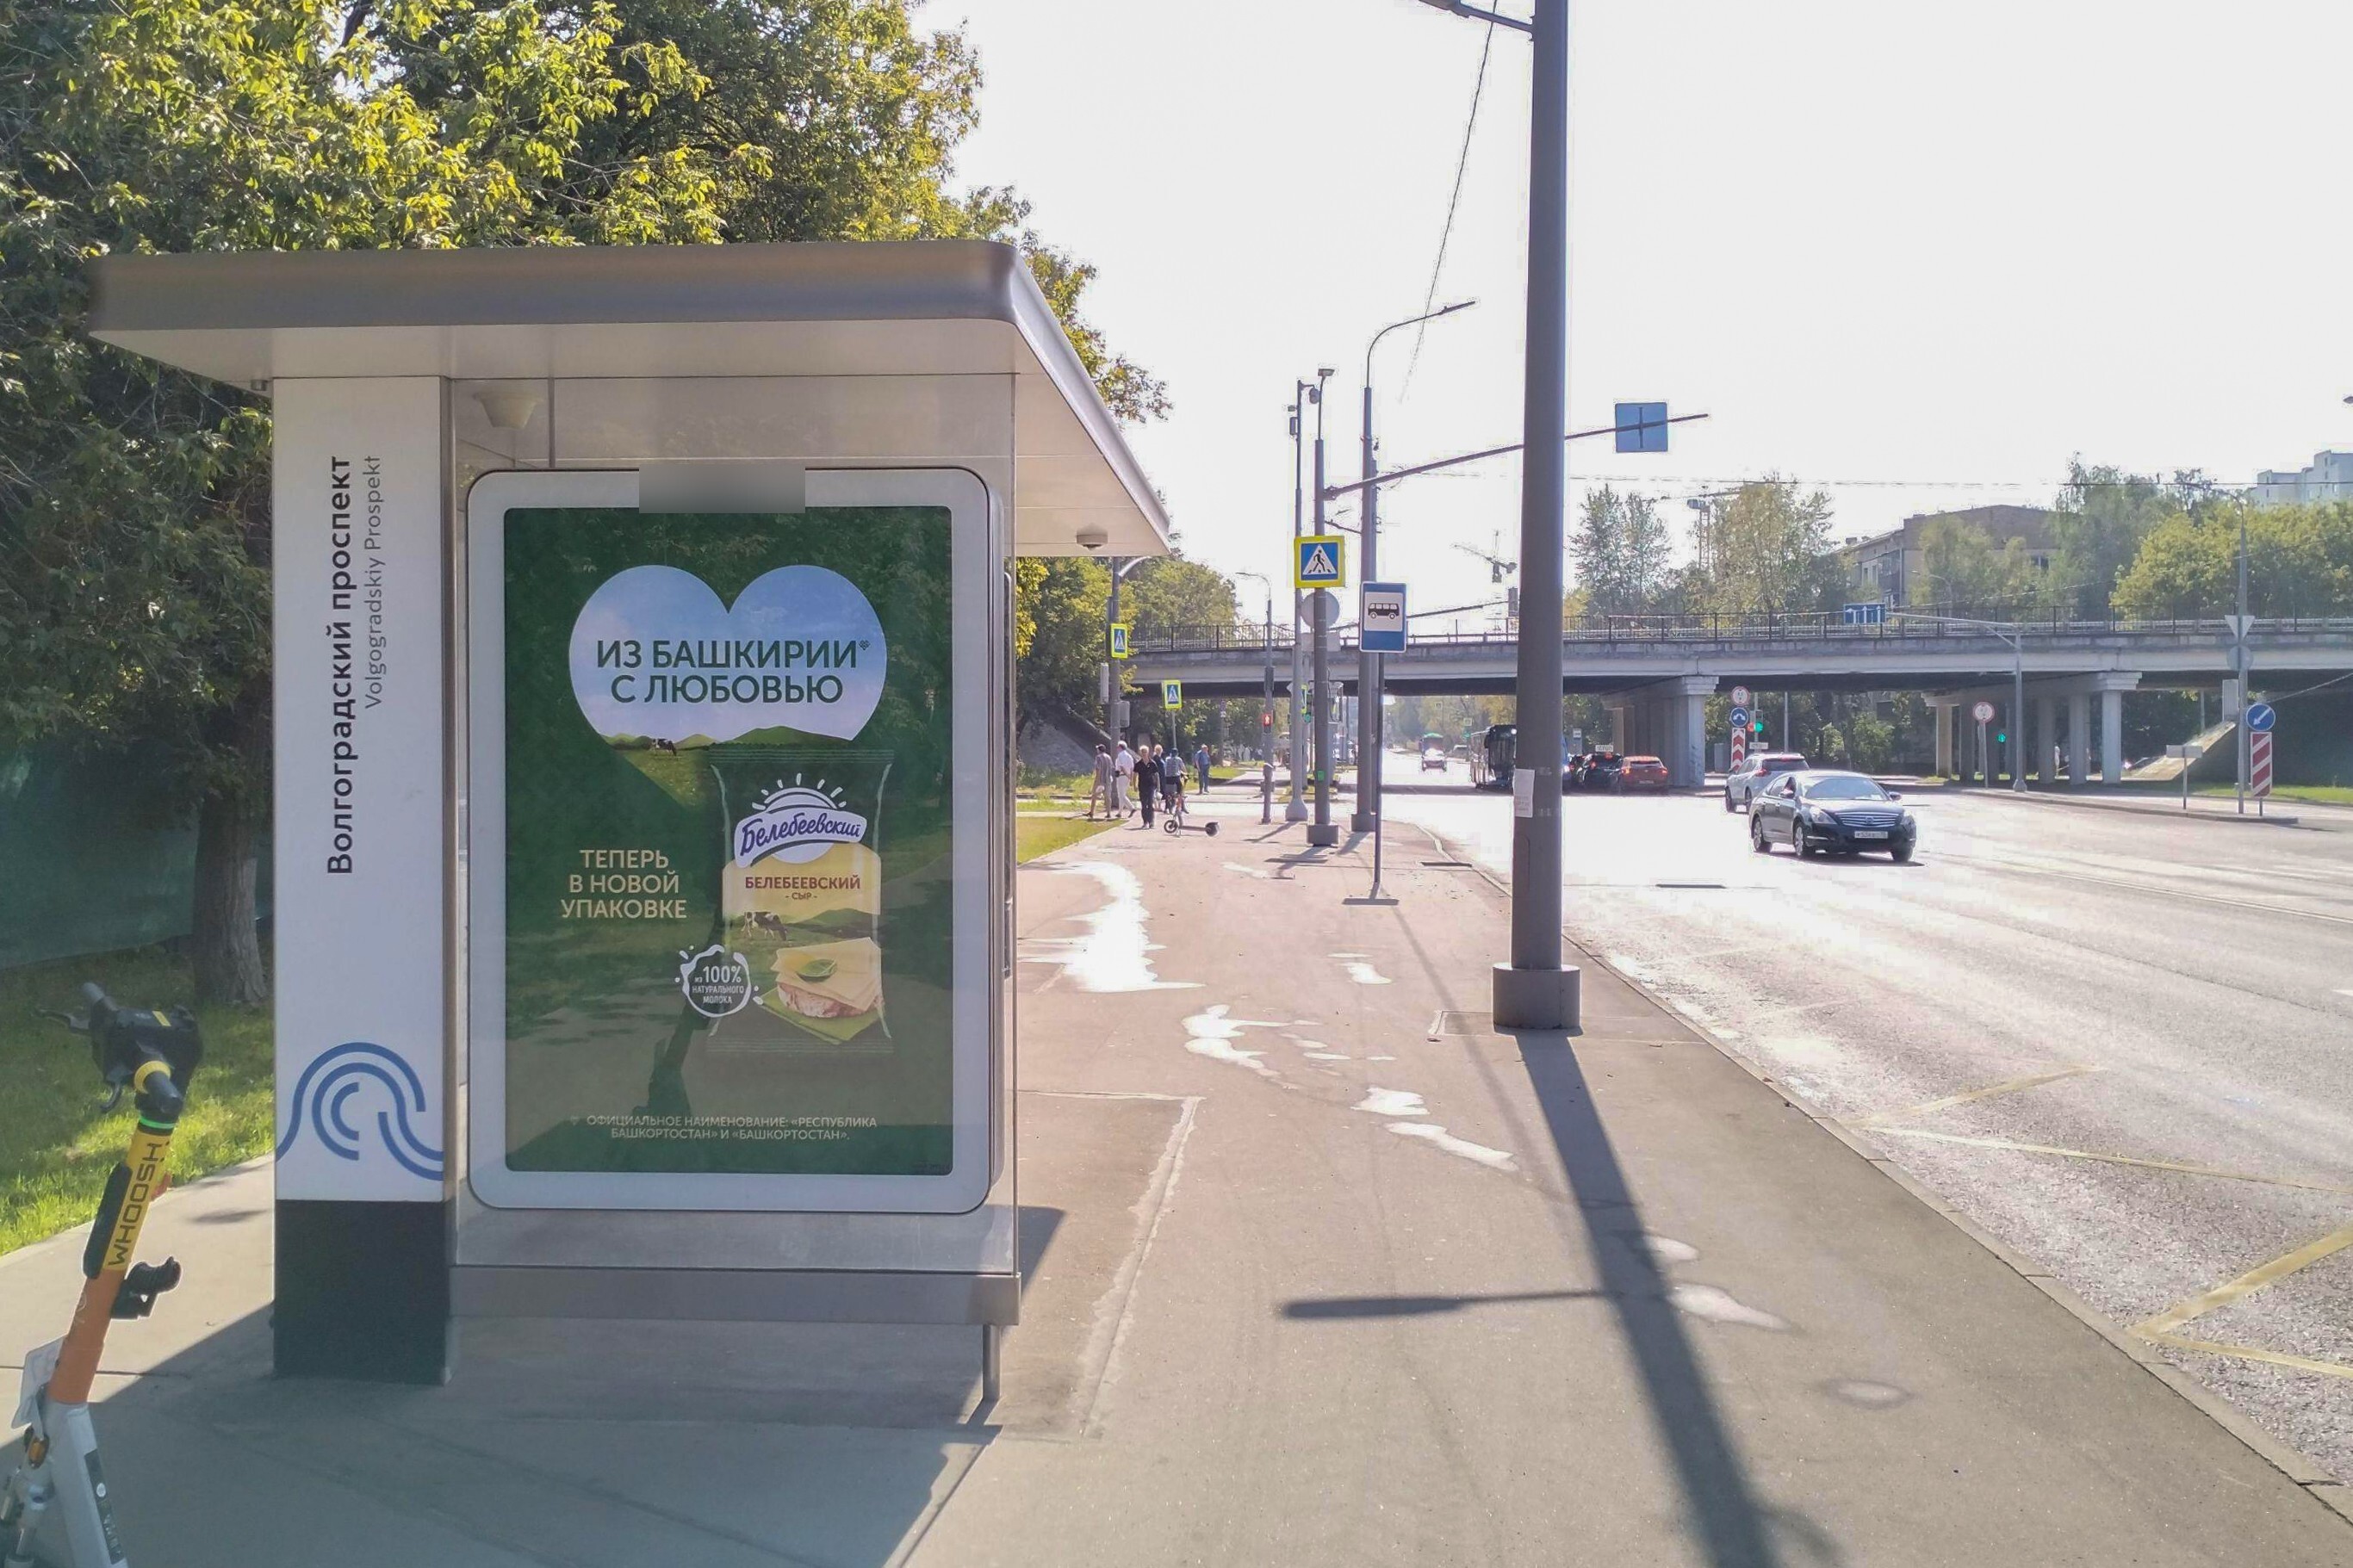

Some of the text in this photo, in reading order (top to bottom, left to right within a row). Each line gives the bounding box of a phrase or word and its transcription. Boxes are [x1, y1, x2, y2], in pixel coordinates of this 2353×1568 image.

[362, 456, 387, 710] Volgogradskiy Prospekt
[596, 640, 857, 668] ИЗ БАШКИРИИ
[326, 456, 358, 874] Волгоградский проспект
[610, 674, 844, 704] С ЛЮБОВЬЮ
[740, 812, 862, 857] Белебеевский
[579, 849, 669, 869] ТЕПЕРЬ
[569, 870, 680, 894] В НОВОЙ
[745, 874, 861, 889] БЕЛЕБЕЕВСКИЙ
[560, 899, 687, 919] УПАКОВКЕ
[703, 965, 742, 983] 100%
[692, 985, 744, 994] НАТУРАЛЬНОГО
[703, 995, 732, 1004] МОЛОКА
[587, 1115, 682, 1127] ОФИЦИАЛЬНОЕ
[791, 1116, 878, 1128] «РЕСПУБЛИКА
[611, 1127, 718, 1139] БАШКОРТОСТАН»
[720, 1129, 729, 1139] И
[108, 1142, 163, 1266] WHOOSH
